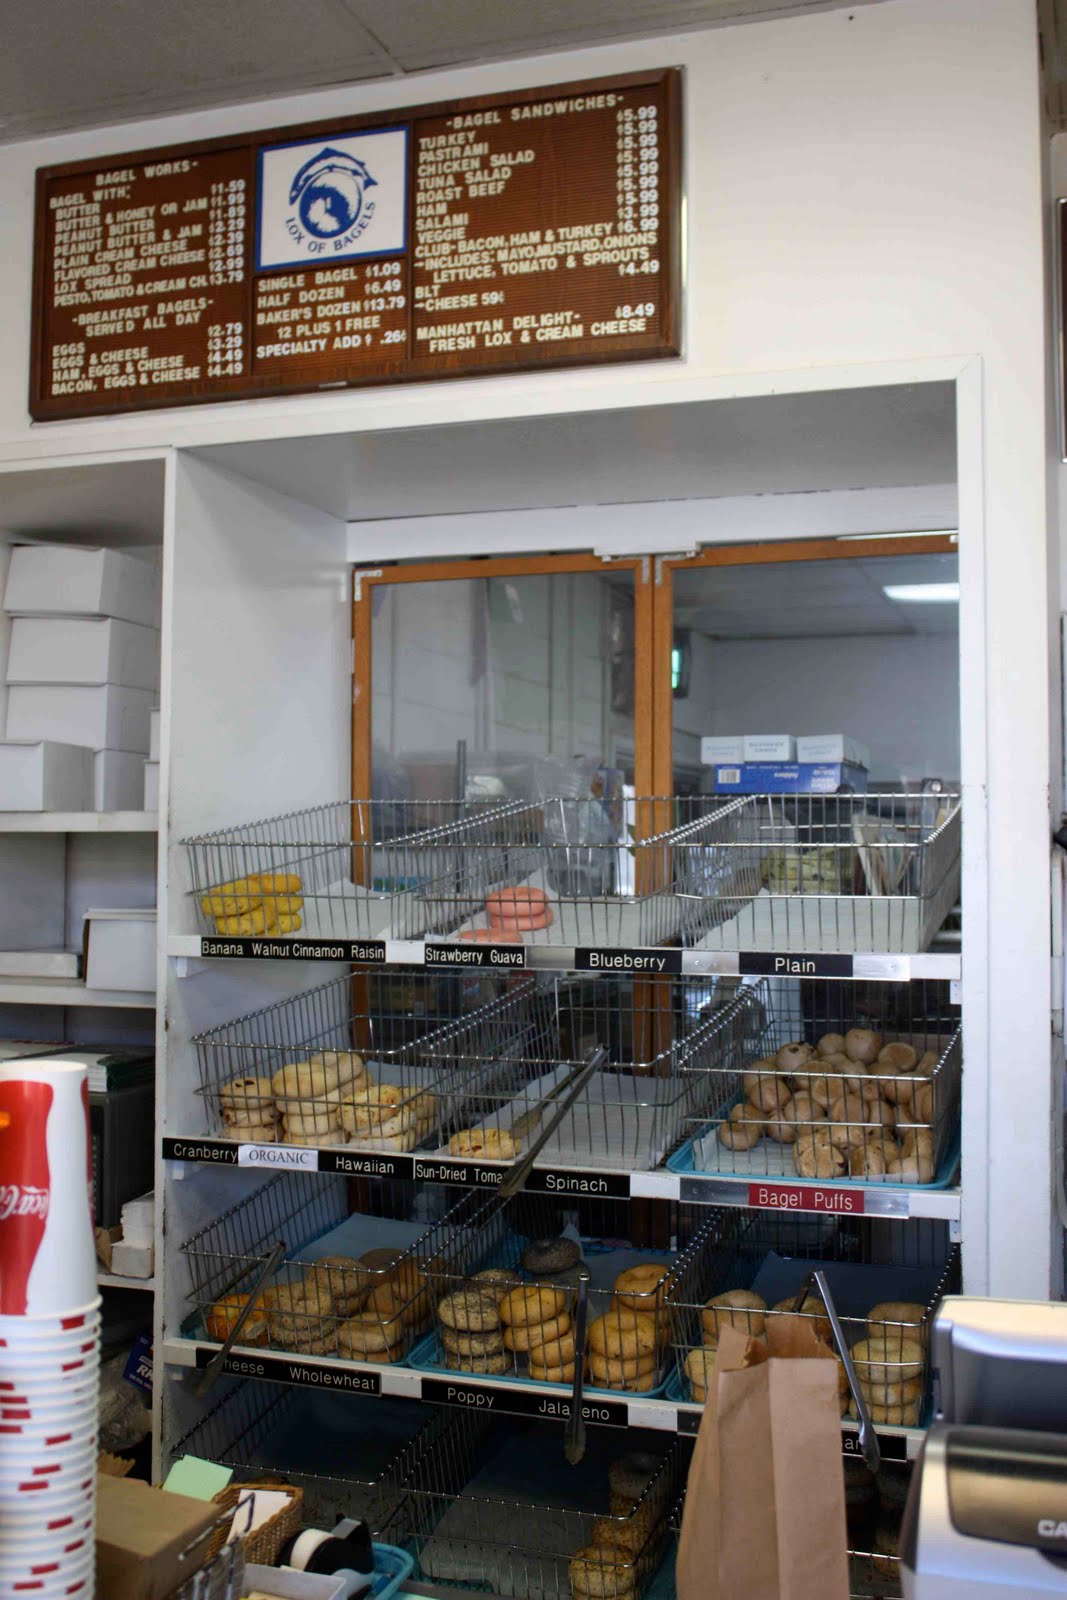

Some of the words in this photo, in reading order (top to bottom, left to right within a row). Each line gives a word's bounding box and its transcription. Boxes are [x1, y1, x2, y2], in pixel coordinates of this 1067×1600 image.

[419, 131, 476, 149] TURKEY
[419, 142, 488, 163] PASTRAMI
[96, 170, 136, 186] BAGEL
[145, 161, 198, 178] WORKS-
[418, 158, 480, 177] CHICKEN
[490, 150, 534, 167] SALAD
[418, 175, 455, 190] TUNA
[465, 167, 511, 184] SALAD
[50, 194, 86, 208] BAGEL
[93, 186, 131, 200] WITH:
[417, 187, 462, 204] ROAST
[469, 182, 505, 198] BEEF
[56, 203, 100, 219] BUTTER
[56, 215, 100, 232] BUTTER
[105, 210, 113, 224] &
[116, 206, 155, 222] HONEY
[161, 203, 178, 215] OR
[183, 197, 208, 213] JAM
[417, 203, 447, 217] HAM
[55, 227, 102, 244] PEANUT
[109, 219, 155, 236] BUTTER
[285, 217, 305, 245] LOX
[307, 240, 326, 252] OF
[334, 201, 375, 251] BAGELS
[416, 214, 469, 231] SALAMI
[544, 230, 555, 242] &
[558, 222, 612, 240] TURKEY
[54, 240, 102, 256] PEANUT
[108, 232, 156, 249] BUTTER
[163, 229, 171, 240] &
[177, 224, 202, 238] JAM
[418, 227, 466, 244] VEGGIE
[54, 253, 89, 270] PLAIN
[95, 247, 135, 263] CREAM
[140, 240, 188, 256] CHEESE
[54, 264, 111, 282] FLAVORED
[115, 256, 157, 273] CREAM
[160, 249, 205, 267] CHEESE
[433, 265, 496, 283] LETTUCE,
[501, 257, 558, 275] TOMATO
[566, 255, 576, 268] &
[584, 246, 650, 266] SPROUTS
[55, 278, 78, 294] LOX
[85, 273, 132, 291] SPREAD
[136, 284, 144, 296] &
[145, 278, 186, 294] CREAM
[258, 274, 305, 292] SINGLE
[315, 267, 357, 284] BAGEL
[258, 292, 291, 308] HALF
[299, 286, 345, 303] DOZEN
[415, 285, 441, 299] BLT
[257, 307, 312, 325] BAKER'S
[317, 300, 361, 317] DOZEN
[86, 320, 134, 336] SERVED
[143, 316, 166, 330] ALL
[176, 311, 200, 325] DAY
[278, 327, 291, 339] 12
[297, 320, 330, 336] PLUS
[335, 320, 341, 332] 1
[346, 316, 380, 332] FREE
[416, 319, 503, 340] MANHATTAN
[256, 338, 327, 358] SPECIALTY
[333, 335, 361, 350] ADD
[429, 335, 476, 353] FRESH
[485, 331, 512, 346] LOX
[521, 331, 530, 343] &
[536, 325, 583, 341] CREAM
[591, 319, 646, 336] CHEESE
[52, 342, 85, 357] EGGS
[52, 356, 84, 370] EGGS
[90, 353, 98, 365] &
[101, 346, 148, 364] CHEESE
[126, 361, 134, 374] &
[137, 355, 184, 372] CHEESE
[52, 380, 98, 395] BACON,
[104, 374, 136, 388] EGGS
[140, 373, 148, 385] &
[152, 366, 200, 382] CHEESE
[202, 942, 243, 956] Banana
[252, 942, 289, 957] Walnut
[292, 943, 344, 958] Cinnamon
[351, 944, 384, 959] Raisin
[425, 947, 483, 966] Strawberry
[490, 950, 523, 964] Guava
[589, 952, 666, 972] Blueberry
[774, 958, 816, 973] Plain
[174, 1144, 238, 1165] Cranberry
[249, 1148, 309, 1164] ORGANIC
[336, 1156, 394, 1174] Hawaiian
[416, 1165, 467, 1181] Sun-Dried
[474, 1168, 502, 1184] Toma
[545, 1174, 608, 1192] Spinach
[758, 1188, 803, 1209] Bagel
[814, 1192, 853, 1210] Puffs
[224, 1359, 264, 1375] heese
[289, 1366, 375, 1390] Wholewheat
[448, 1388, 494, 1408] Poppy
[538, 1400, 610, 1420] Jalaeno
